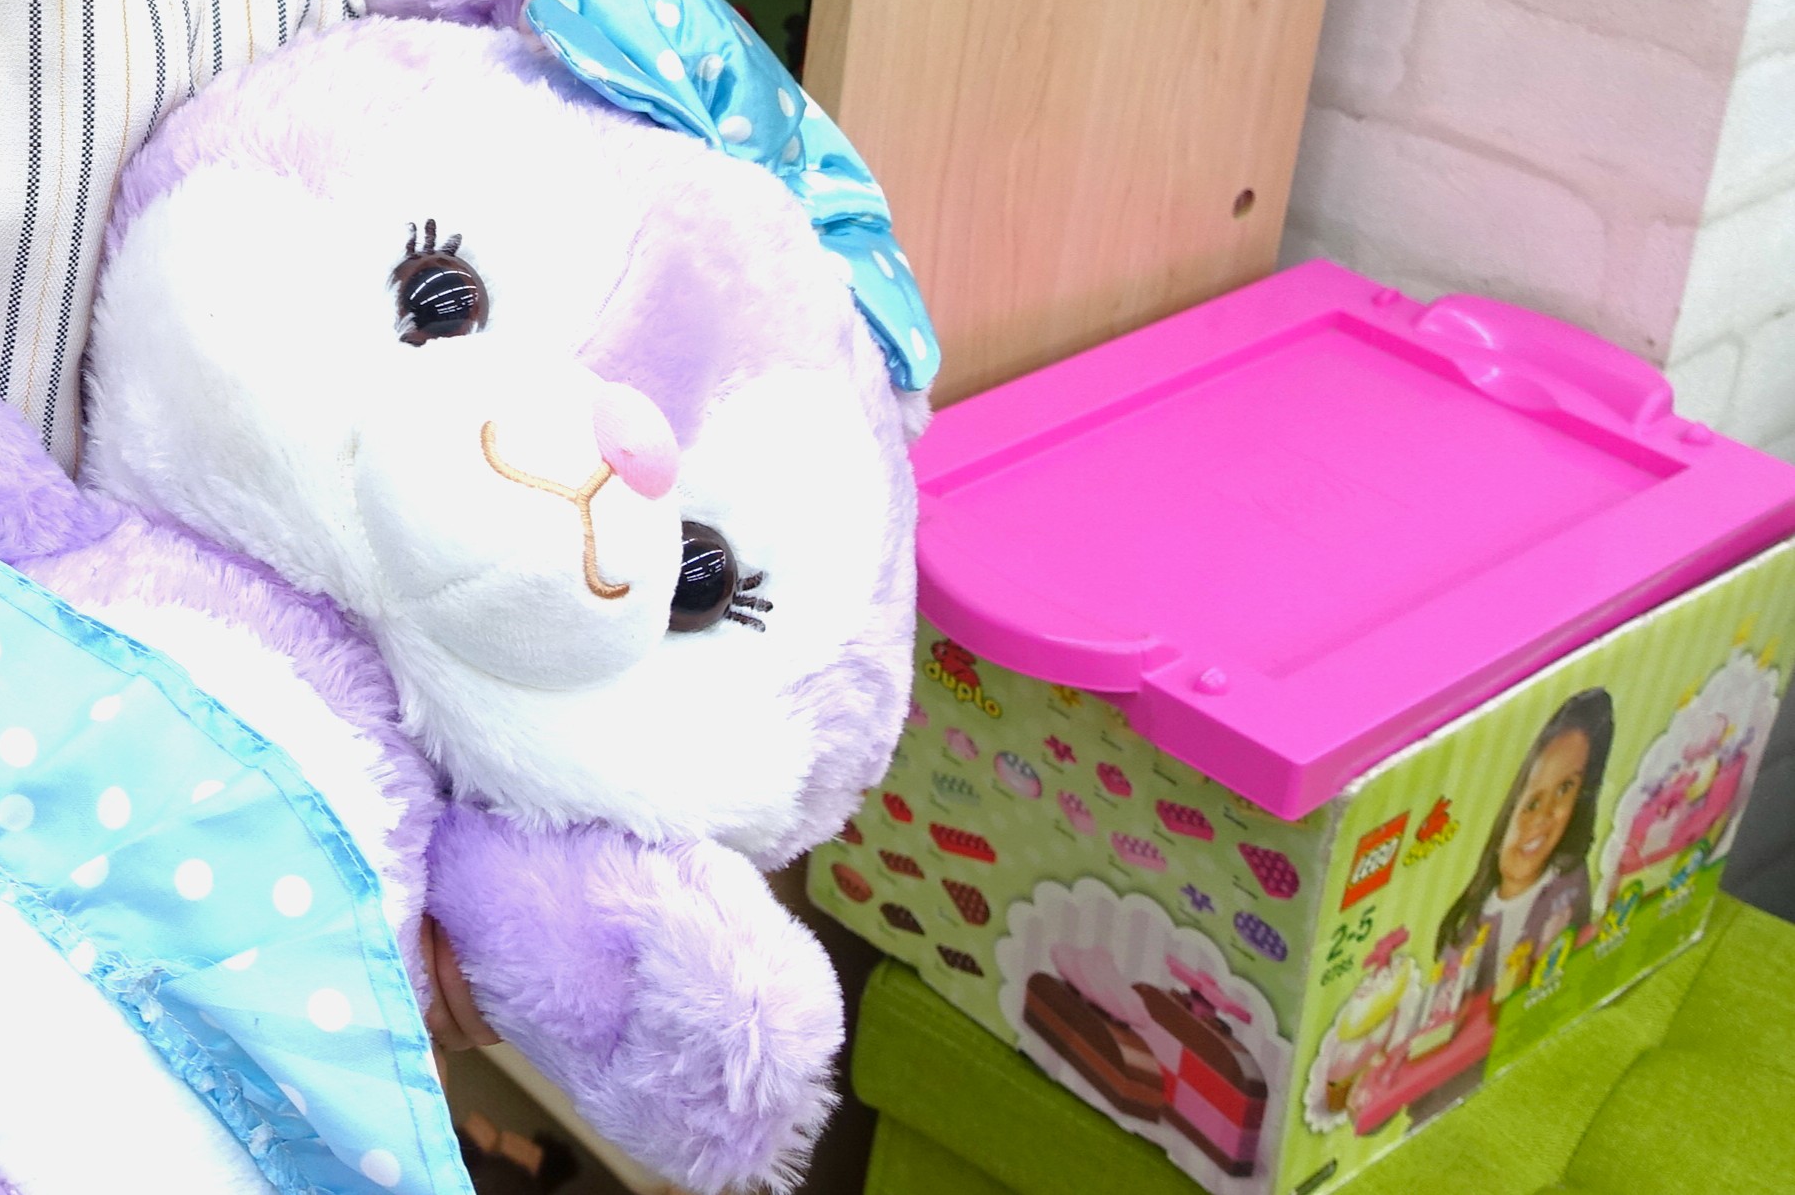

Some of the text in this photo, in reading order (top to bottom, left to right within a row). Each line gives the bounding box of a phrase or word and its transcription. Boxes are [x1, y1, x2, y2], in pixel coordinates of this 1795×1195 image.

[923, 660, 1003, 718] duplo
[1351, 836, 1400, 885] LEGO
[1326, 904, 1377, 962] 2-5
